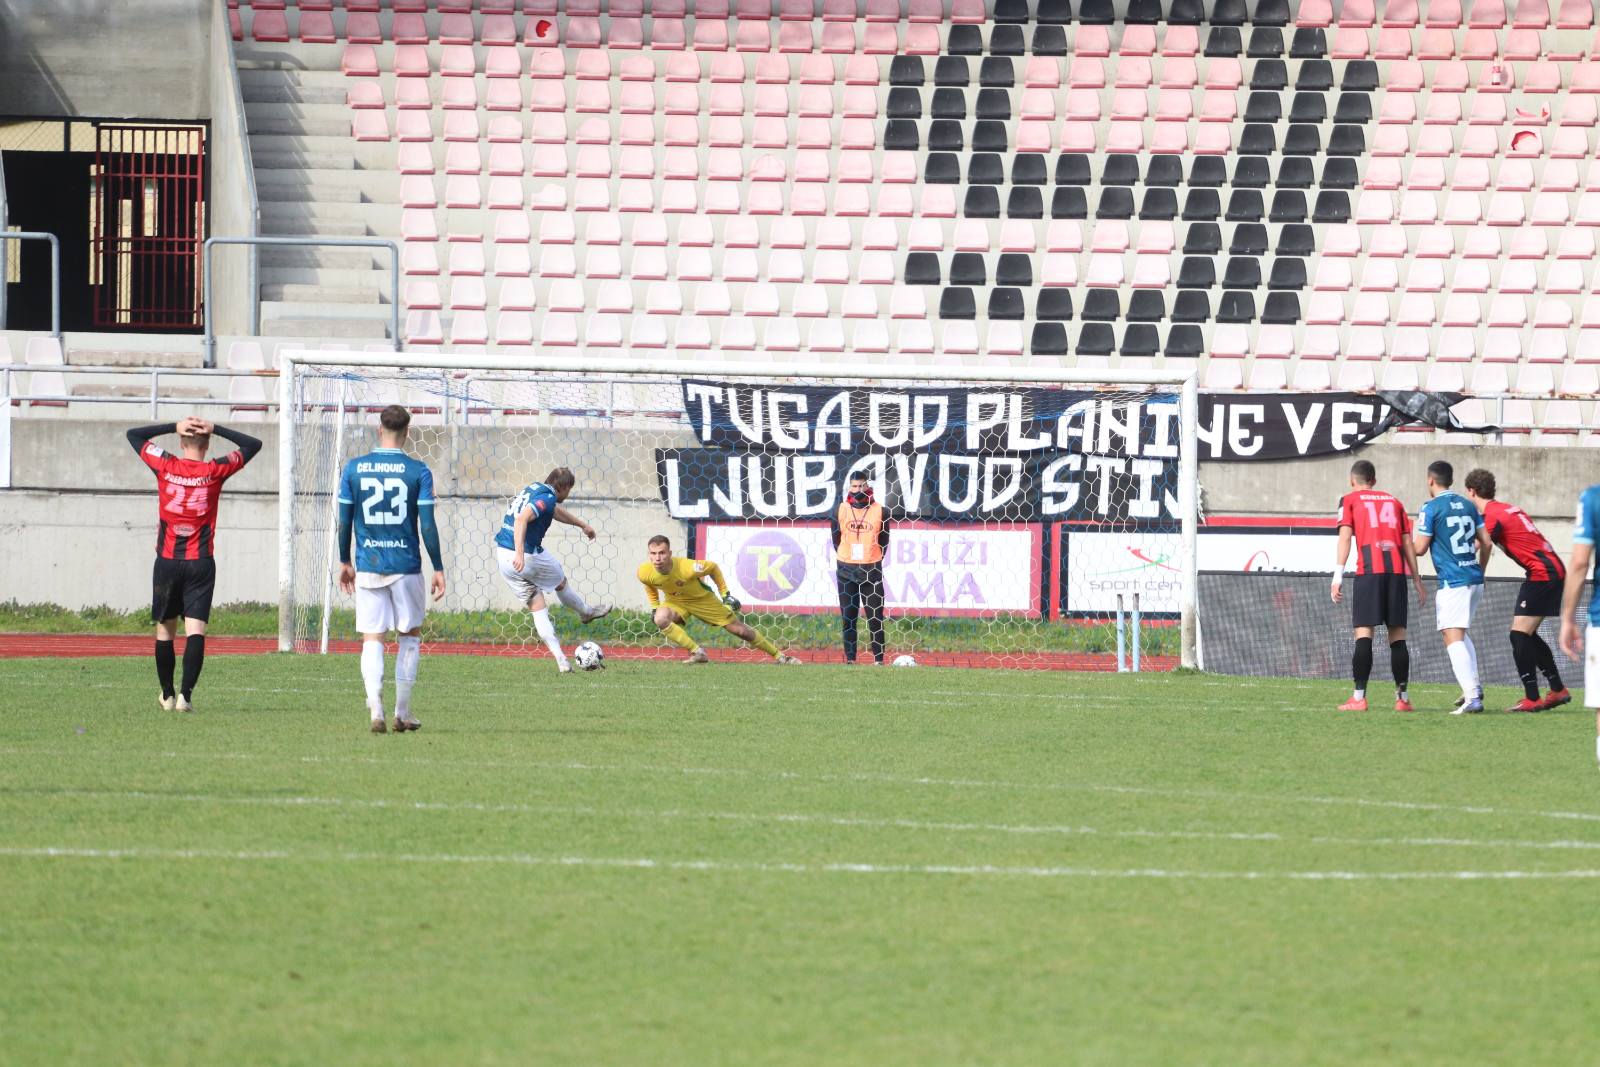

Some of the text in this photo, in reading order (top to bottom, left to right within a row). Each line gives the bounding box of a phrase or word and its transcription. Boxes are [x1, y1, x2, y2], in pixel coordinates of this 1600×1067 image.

[868, 392, 949, 449] OD
[1281, 402, 1391, 455] VE
[164, 483, 208, 516] 24
[360, 477, 408, 525] 23
[939, 454, 1022, 513] OD
[1363, 501, 1398, 528] 14
[363, 539, 408, 548] ADMIRAL
[746, 545, 794, 590] TK
[1145, 579, 1182, 591] cen
